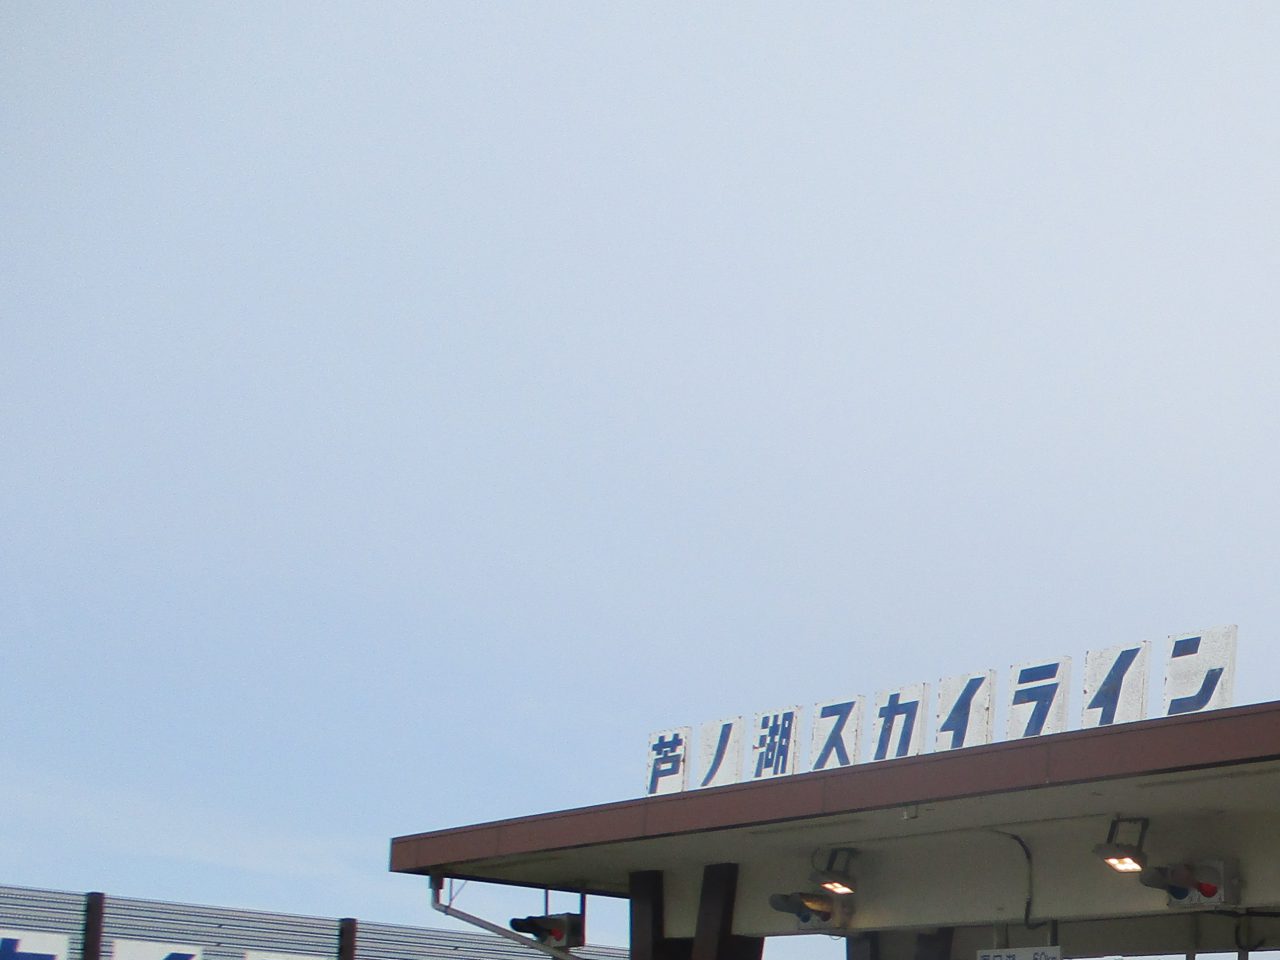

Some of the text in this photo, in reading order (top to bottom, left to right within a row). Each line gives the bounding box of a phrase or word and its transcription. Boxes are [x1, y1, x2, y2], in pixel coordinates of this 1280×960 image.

[650, 636, 1224, 795] 芦ノ湖スカイライン
